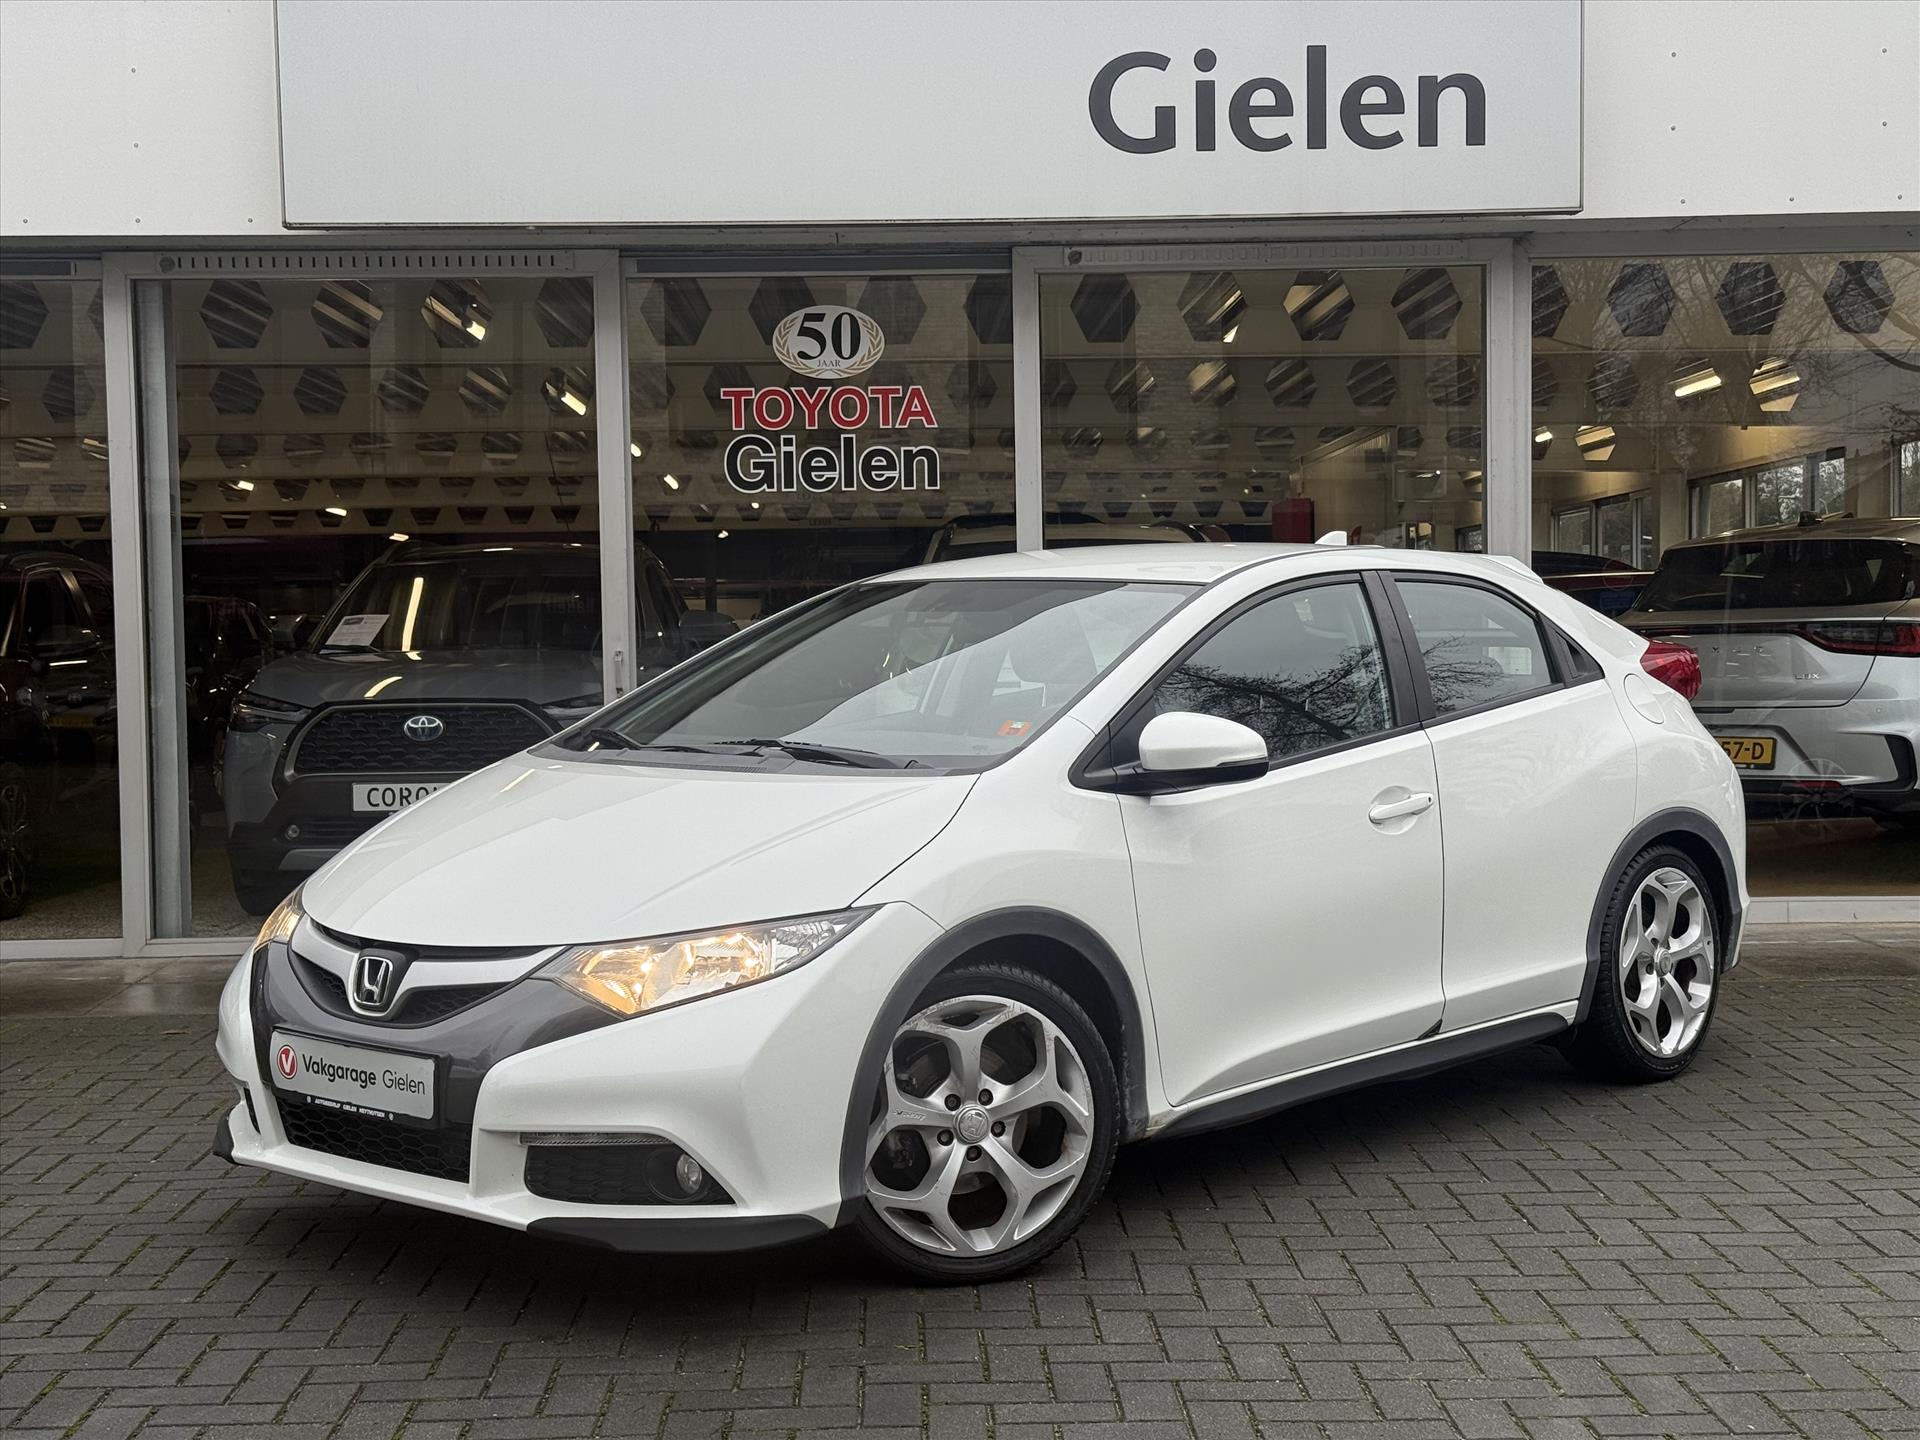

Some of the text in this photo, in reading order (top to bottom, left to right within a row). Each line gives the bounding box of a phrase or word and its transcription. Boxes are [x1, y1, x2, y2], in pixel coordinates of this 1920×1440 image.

[1088, 44, 1487, 155] Gielen
[796, 311, 861, 360] 50
[817, 359, 842, 368] JAAR
[720, 385, 938, 431] TOYOTA
[724, 433, 941, 493] Gielen
[366, 786, 438, 808] CORO
[302, 1053, 377, 1089] Vakgarage
[382, 1069, 426, 1096] Gielen
